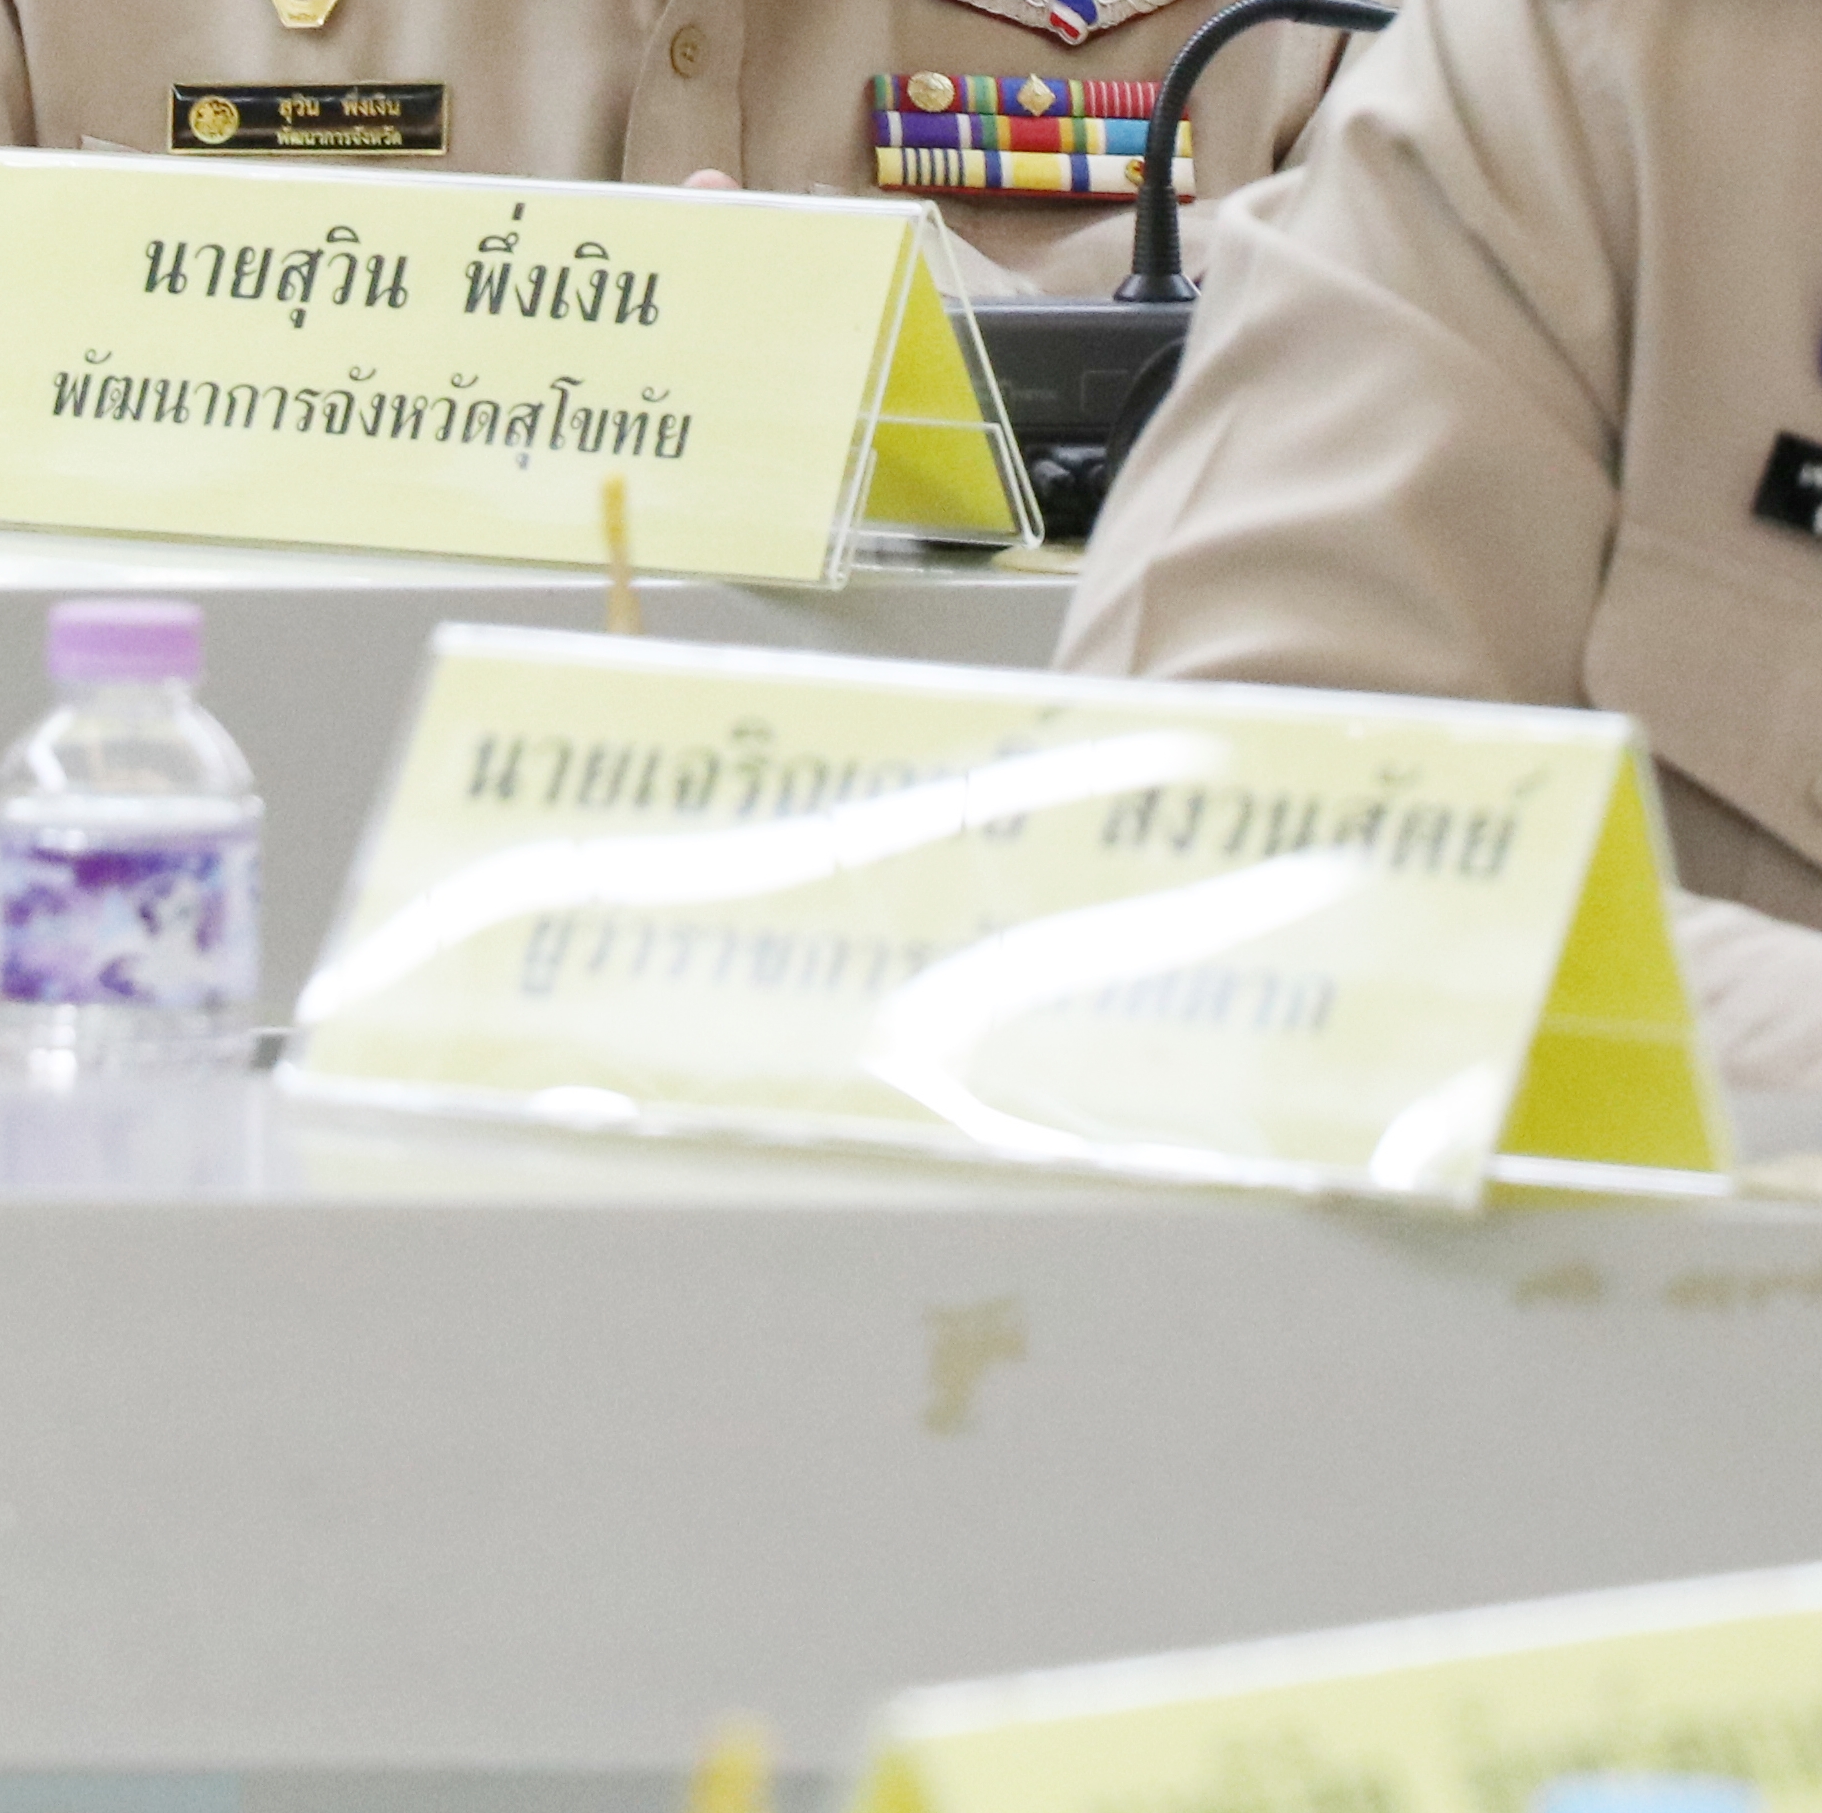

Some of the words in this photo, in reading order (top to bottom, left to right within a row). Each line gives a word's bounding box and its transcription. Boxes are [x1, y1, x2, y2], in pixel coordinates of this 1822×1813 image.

[143, 225, 410, 329] นายสุวิน
[464, 202, 660, 327] พึ่งเงิน
[51, 347, 693, 470] พัฒนาการจังหวัดสุโขทัย
